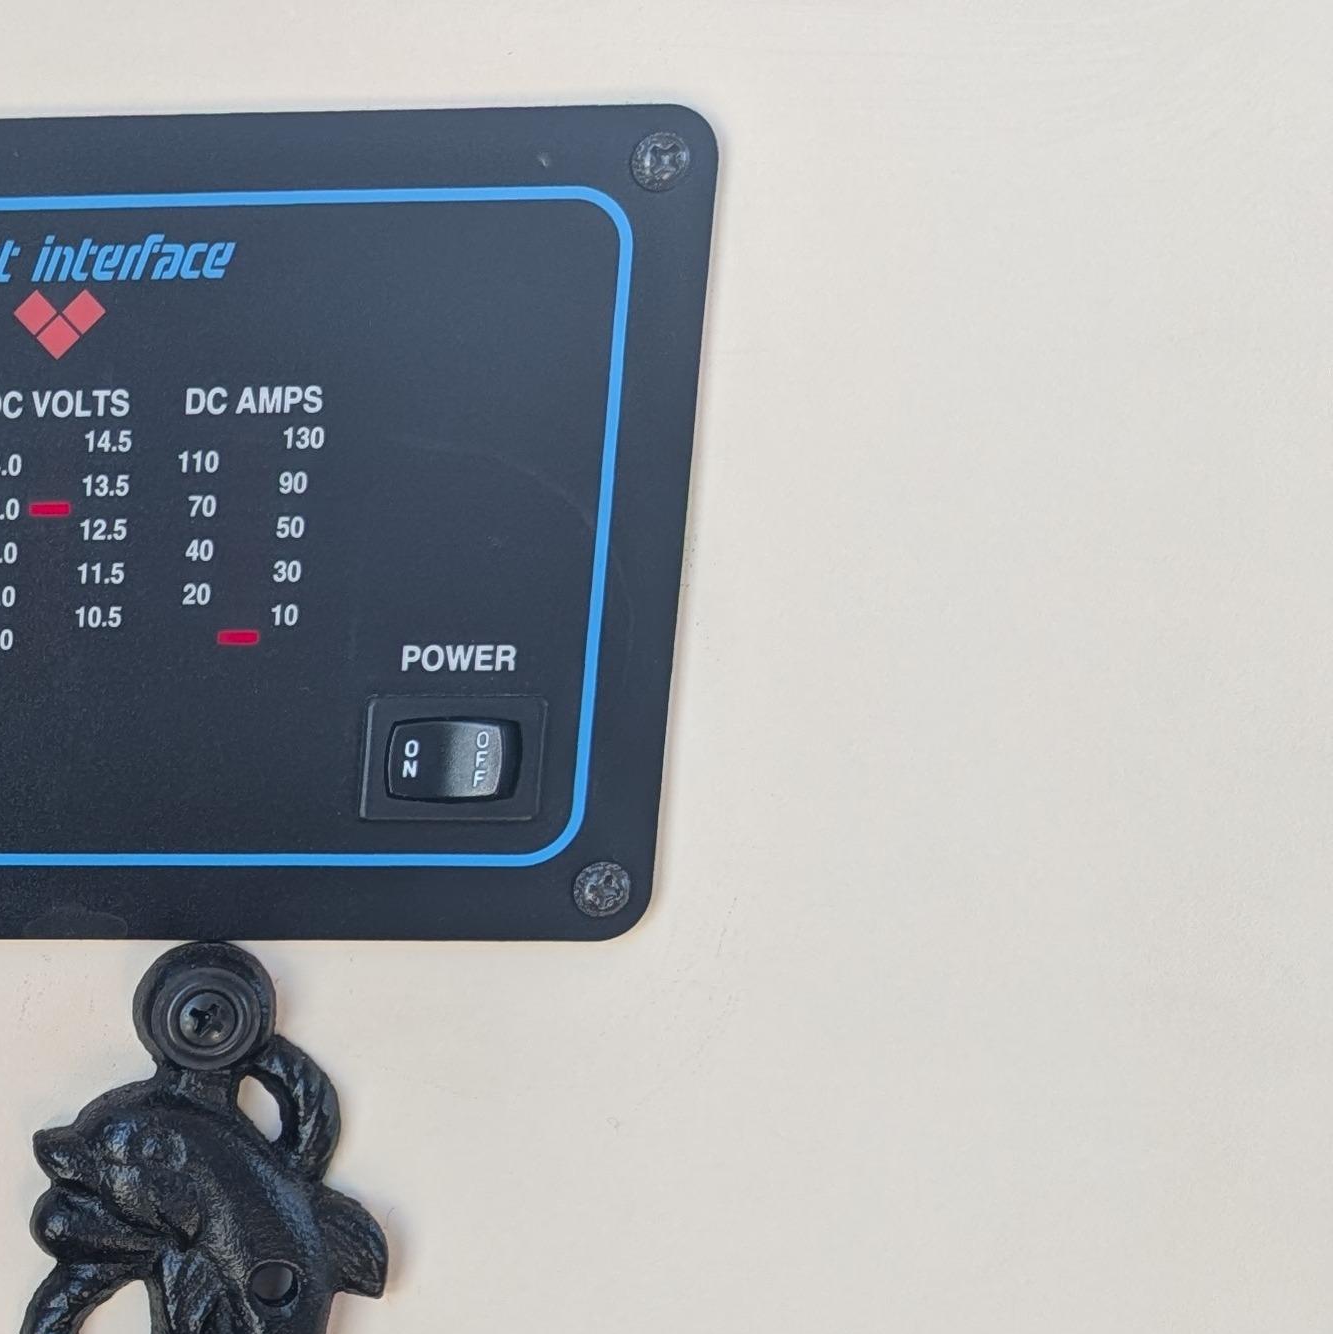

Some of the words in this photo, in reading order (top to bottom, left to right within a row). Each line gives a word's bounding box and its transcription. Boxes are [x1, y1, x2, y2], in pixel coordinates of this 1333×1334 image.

[31, 233, 236, 282] interface
[31, 388, 130, 418] VOLTS
[185, 386, 228, 415] DC
[235, 385, 323, 415] AMPS
[84, 429, 132, 453] 14.5
[283, 426, 325, 450] 130
[178, 450, 220, 473] 110
[82, 474, 130, 497] 13.5
[279, 471, 308, 495] 90
[188, 494, 217, 518] 70
[80, 518, 127, 541] 12.5
[276, 515, 305, 539] 50
[185, 539, 214, 562] 40
[77, 562, 125, 585] 11.5
[272, 560, 302, 583] 30
[182, 582, 211, 606] 20
[75, 605, 122, 628] 10.5
[271, 603, 299, 627] 10
[401, 644, 517, 672] POWER
[402, 739, 419, 778] ON
[472, 731, 490, 788] OFF
